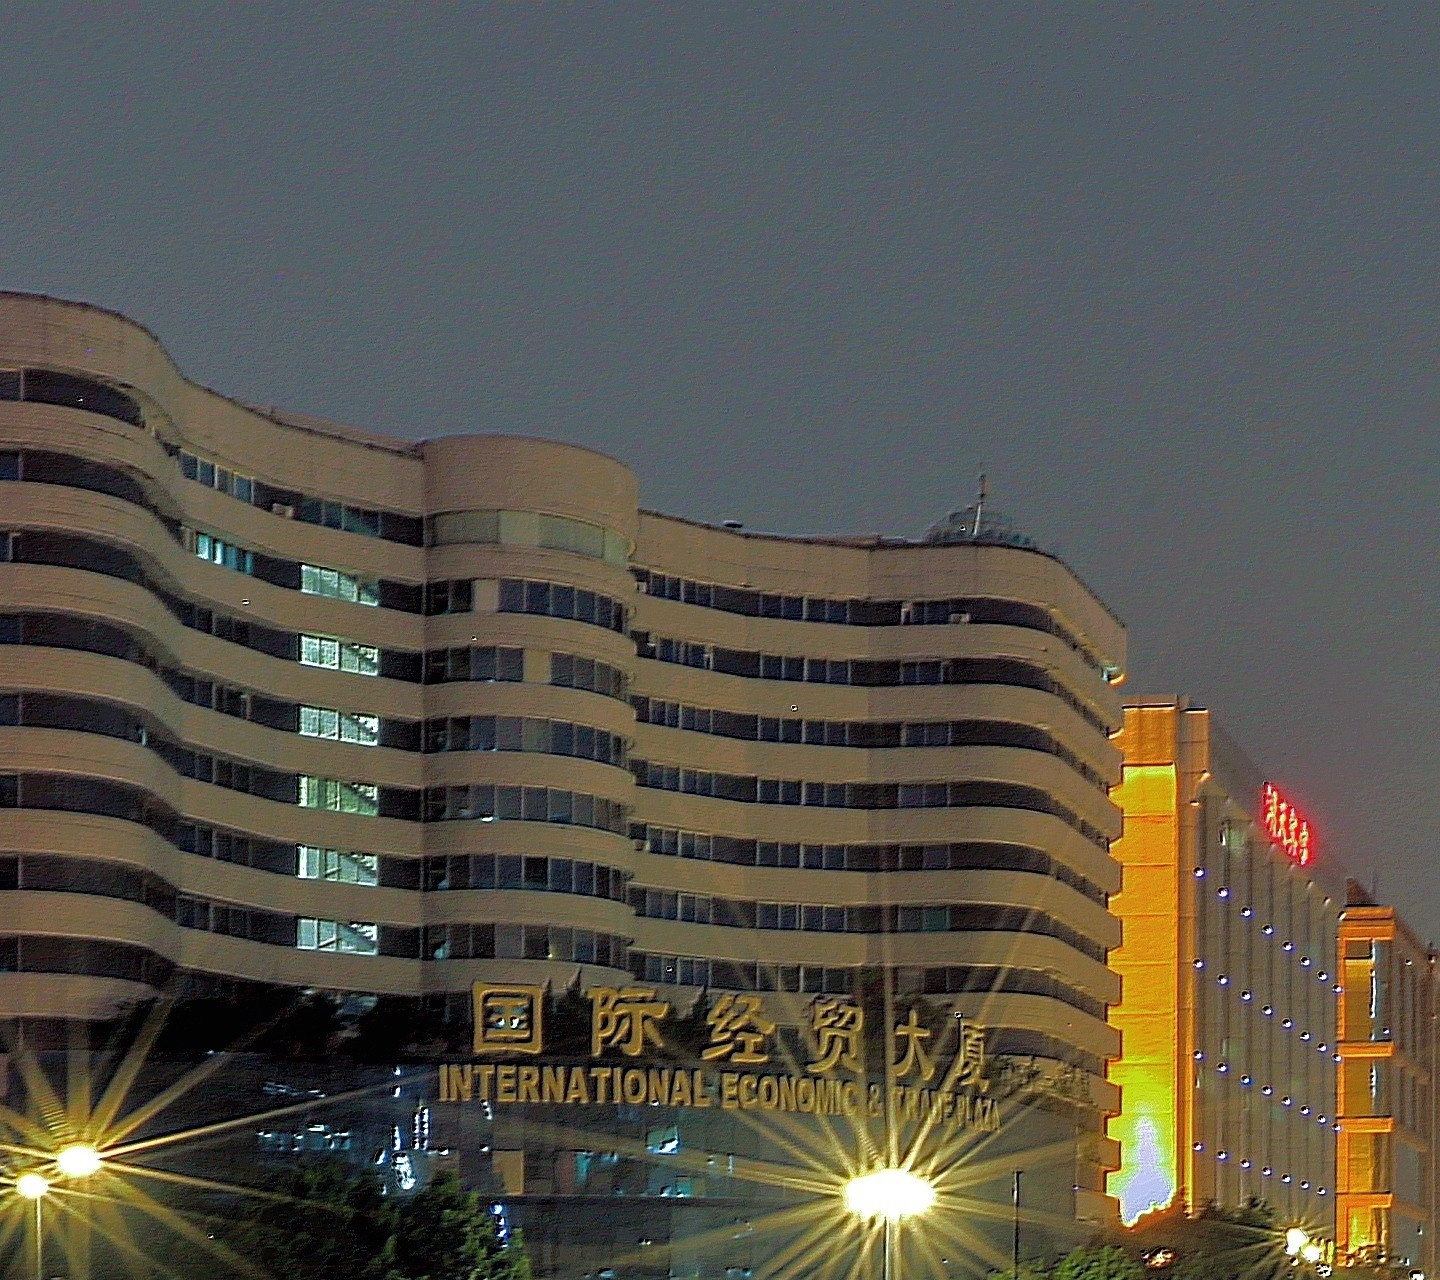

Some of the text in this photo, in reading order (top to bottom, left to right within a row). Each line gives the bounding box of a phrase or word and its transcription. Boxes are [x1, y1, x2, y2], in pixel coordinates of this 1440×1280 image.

[470, 980, 992, 1094] 国际经贸大厦
[438, 1063, 711, 1107] INTERNATIONAL
[721, 1072, 861, 1116] ECONOMIC
[868, 1081, 885, 1116] &
